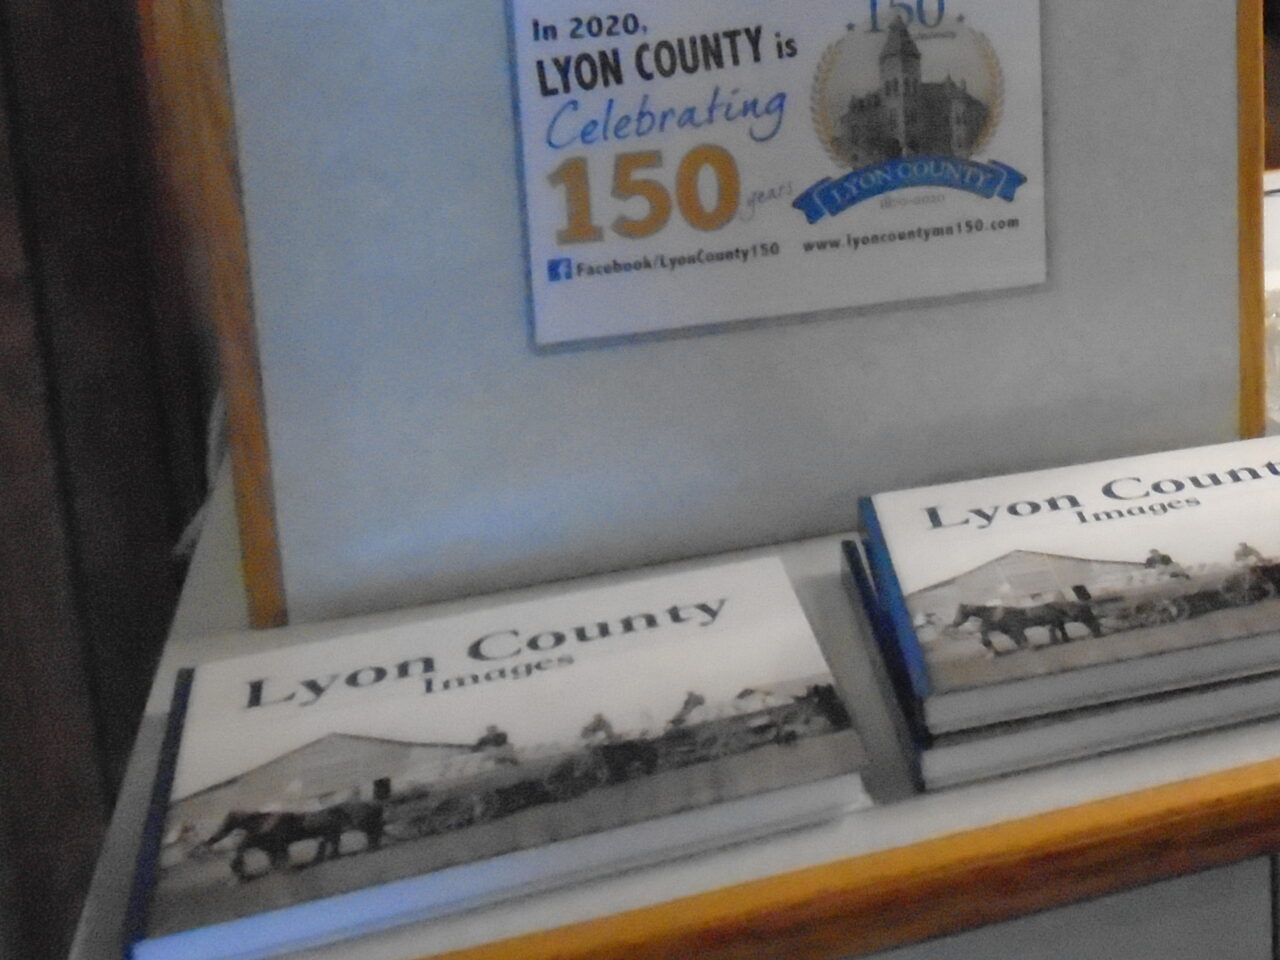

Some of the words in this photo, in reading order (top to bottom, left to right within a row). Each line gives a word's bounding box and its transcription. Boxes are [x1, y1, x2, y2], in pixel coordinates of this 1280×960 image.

[532, 19, 558, 41] In
[536, 48, 624, 97] LYON
[634, 25, 762, 81] COUNTY
[775, 32, 798, 60] is
[546, 86, 788, 149] Celebrating
[546, 144, 742, 245] 150
[742, 179, 794, 223] years
[834, 167, 893, 204] LYON
[895, 161, 988, 189] COUNTY
[802, 215, 1021, 253] www.lyoncountymn150.com
[576, 241, 781, 278] Facebook/LyonCounty150
[922, 492, 1082, 531] Lyon
[1075, 495, 1201, 525] Images
[246, 656, 436, 710] Lyon
[467, 598, 728, 662] County
[424, 654, 575, 695] Images
